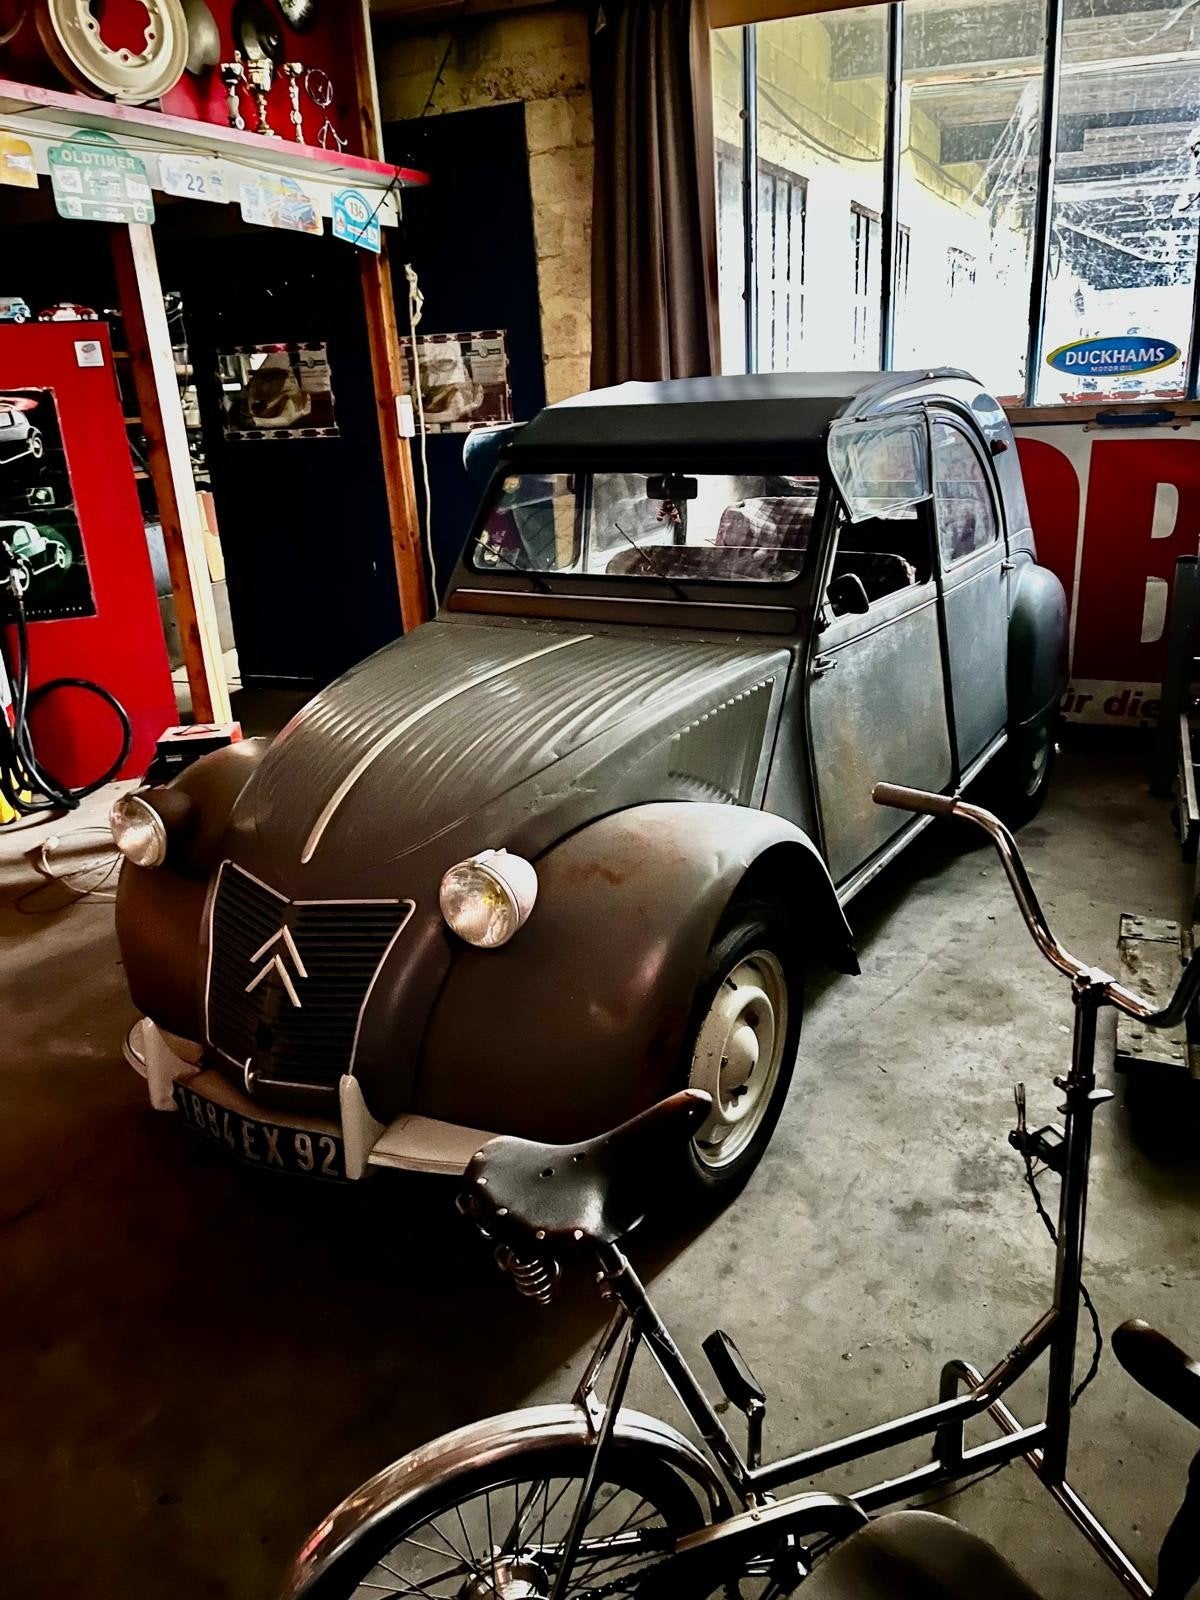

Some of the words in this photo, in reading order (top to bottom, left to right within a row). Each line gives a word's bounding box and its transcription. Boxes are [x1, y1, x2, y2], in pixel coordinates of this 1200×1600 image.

[61, 149, 135, 169] OLDTIMER
[185, 173, 206, 193] 22
[1065, 347, 1166, 366] DUCKHAMS
[1103, 690, 1161, 718] die
[294, 1132, 338, 1177] 92
